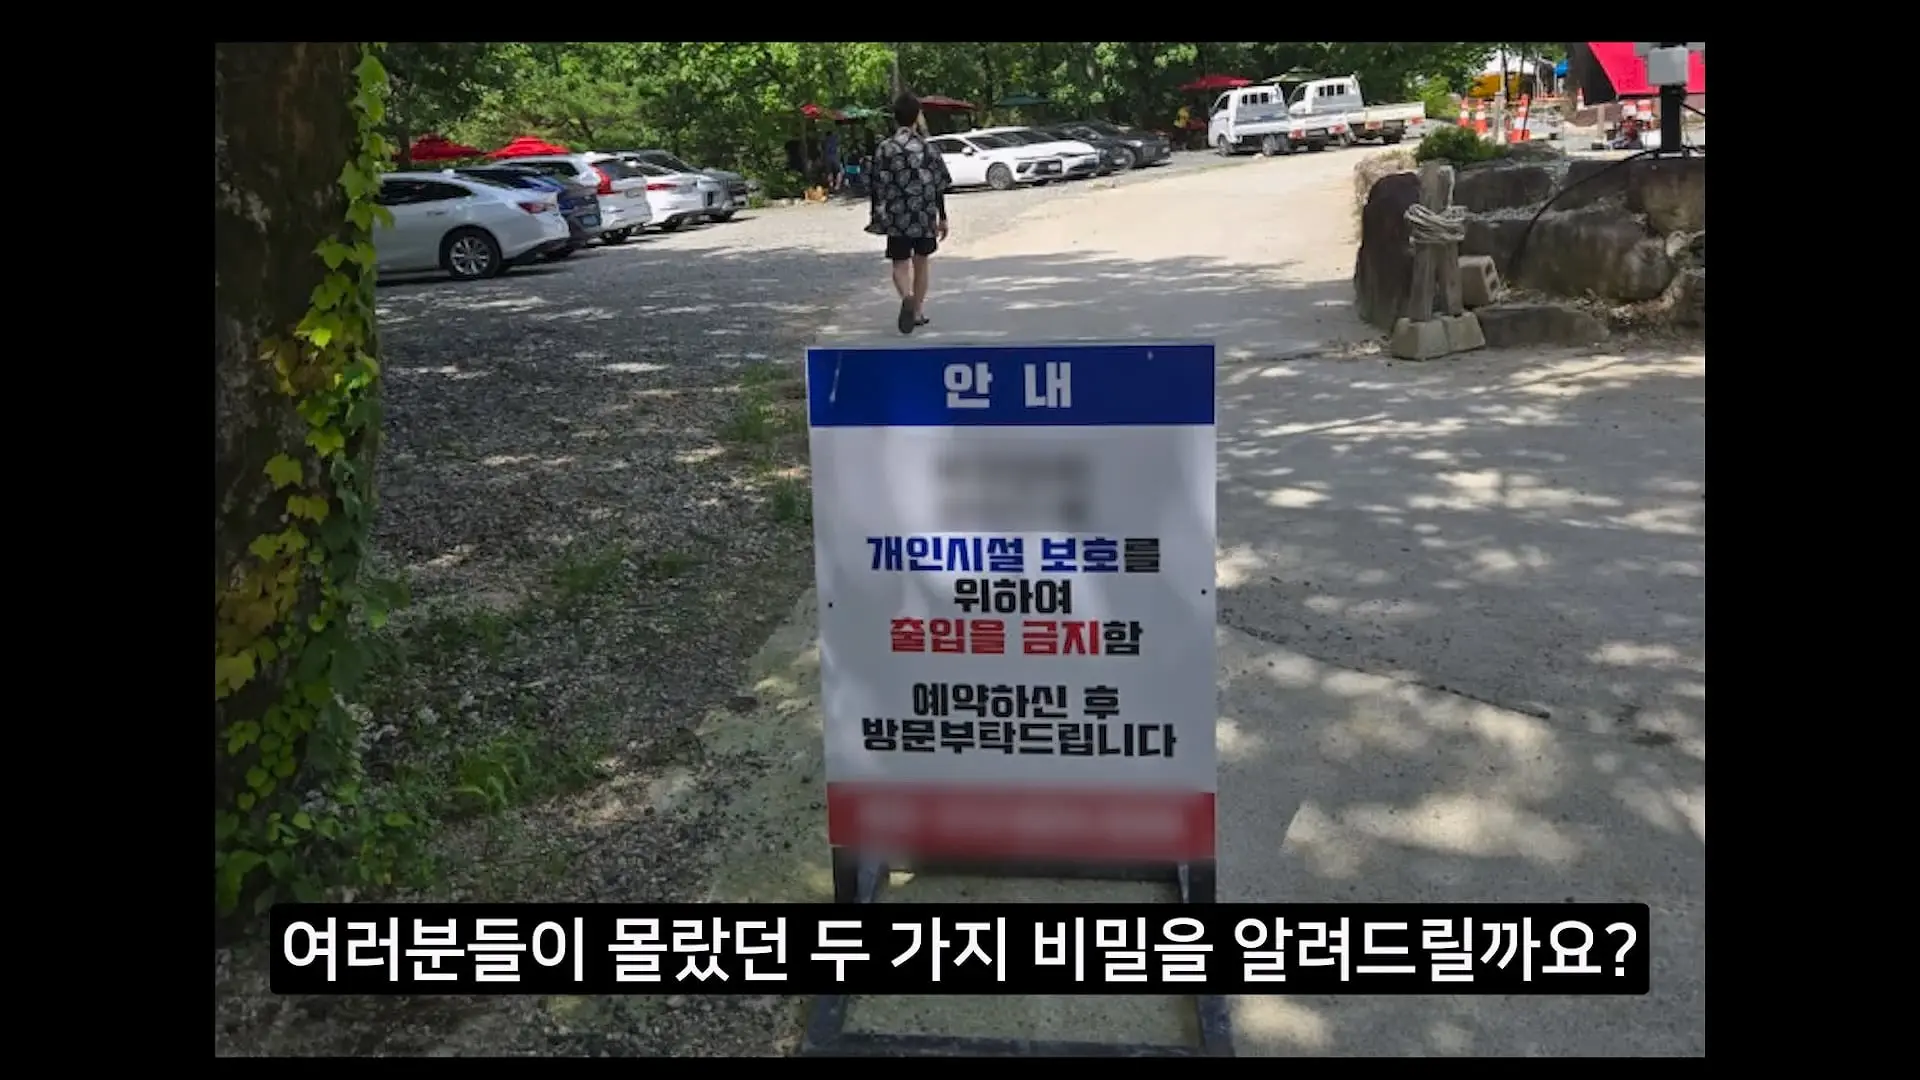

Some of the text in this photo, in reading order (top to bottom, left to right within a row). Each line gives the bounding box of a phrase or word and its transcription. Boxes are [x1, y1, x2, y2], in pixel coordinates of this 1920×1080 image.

[943, 361, 1072, 409] 안 내
[866, 536, 1161, 573] 개인시설 보호를
[953, 578, 1072, 614] 위하여
[890, 617, 1144, 656] 출입을 금지함
[912, 682, 1120, 720] 예약하신 후
[862, 717, 1177, 758] 방문부탁드립니다
